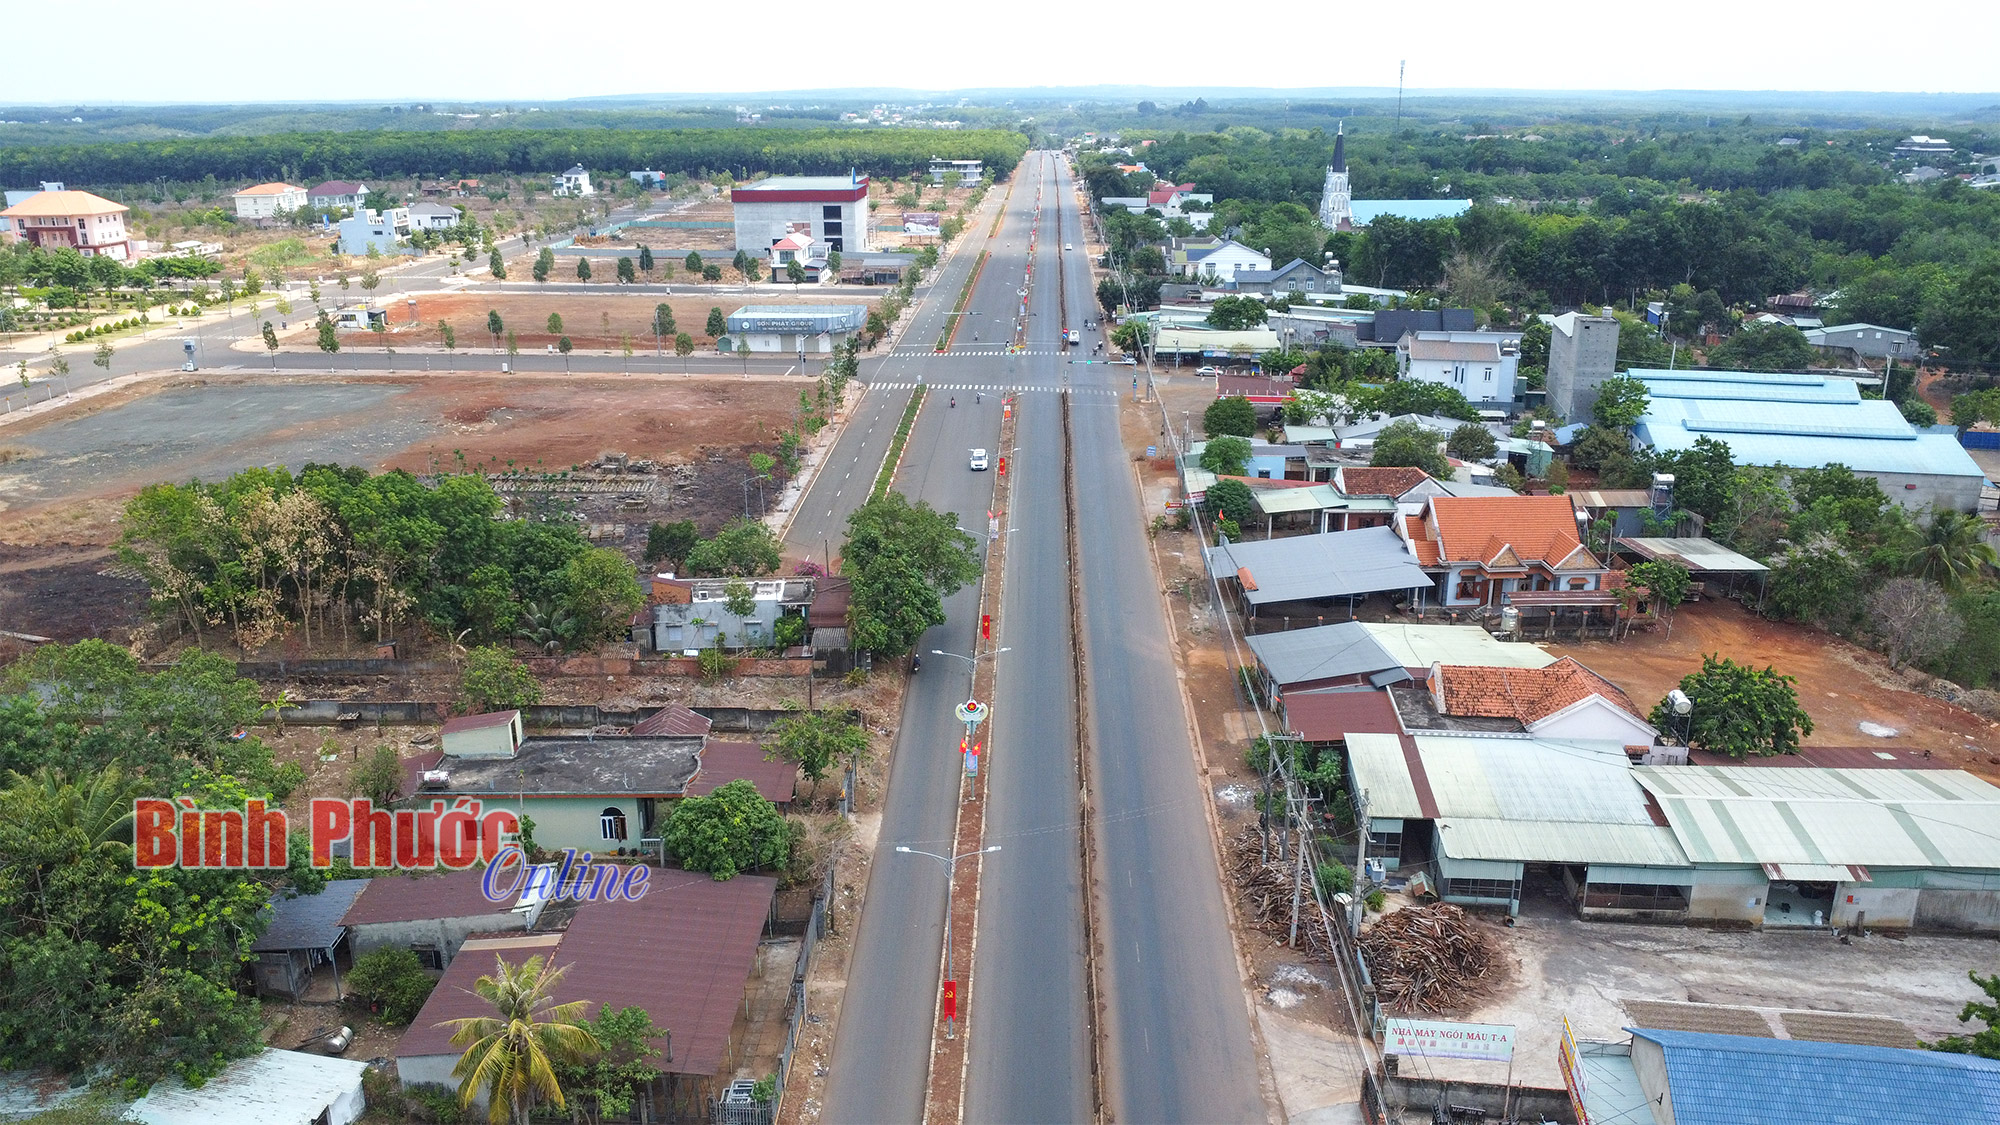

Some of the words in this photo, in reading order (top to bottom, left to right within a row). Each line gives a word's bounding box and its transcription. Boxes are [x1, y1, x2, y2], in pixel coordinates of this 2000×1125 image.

[1391, 1026, 1412, 1036] NHÀ
[1415, 1028, 1437, 1038] MÁY
[1439, 1030, 1463, 1040] NGÓI
[1466, 1031, 1488, 1041] MÀU
